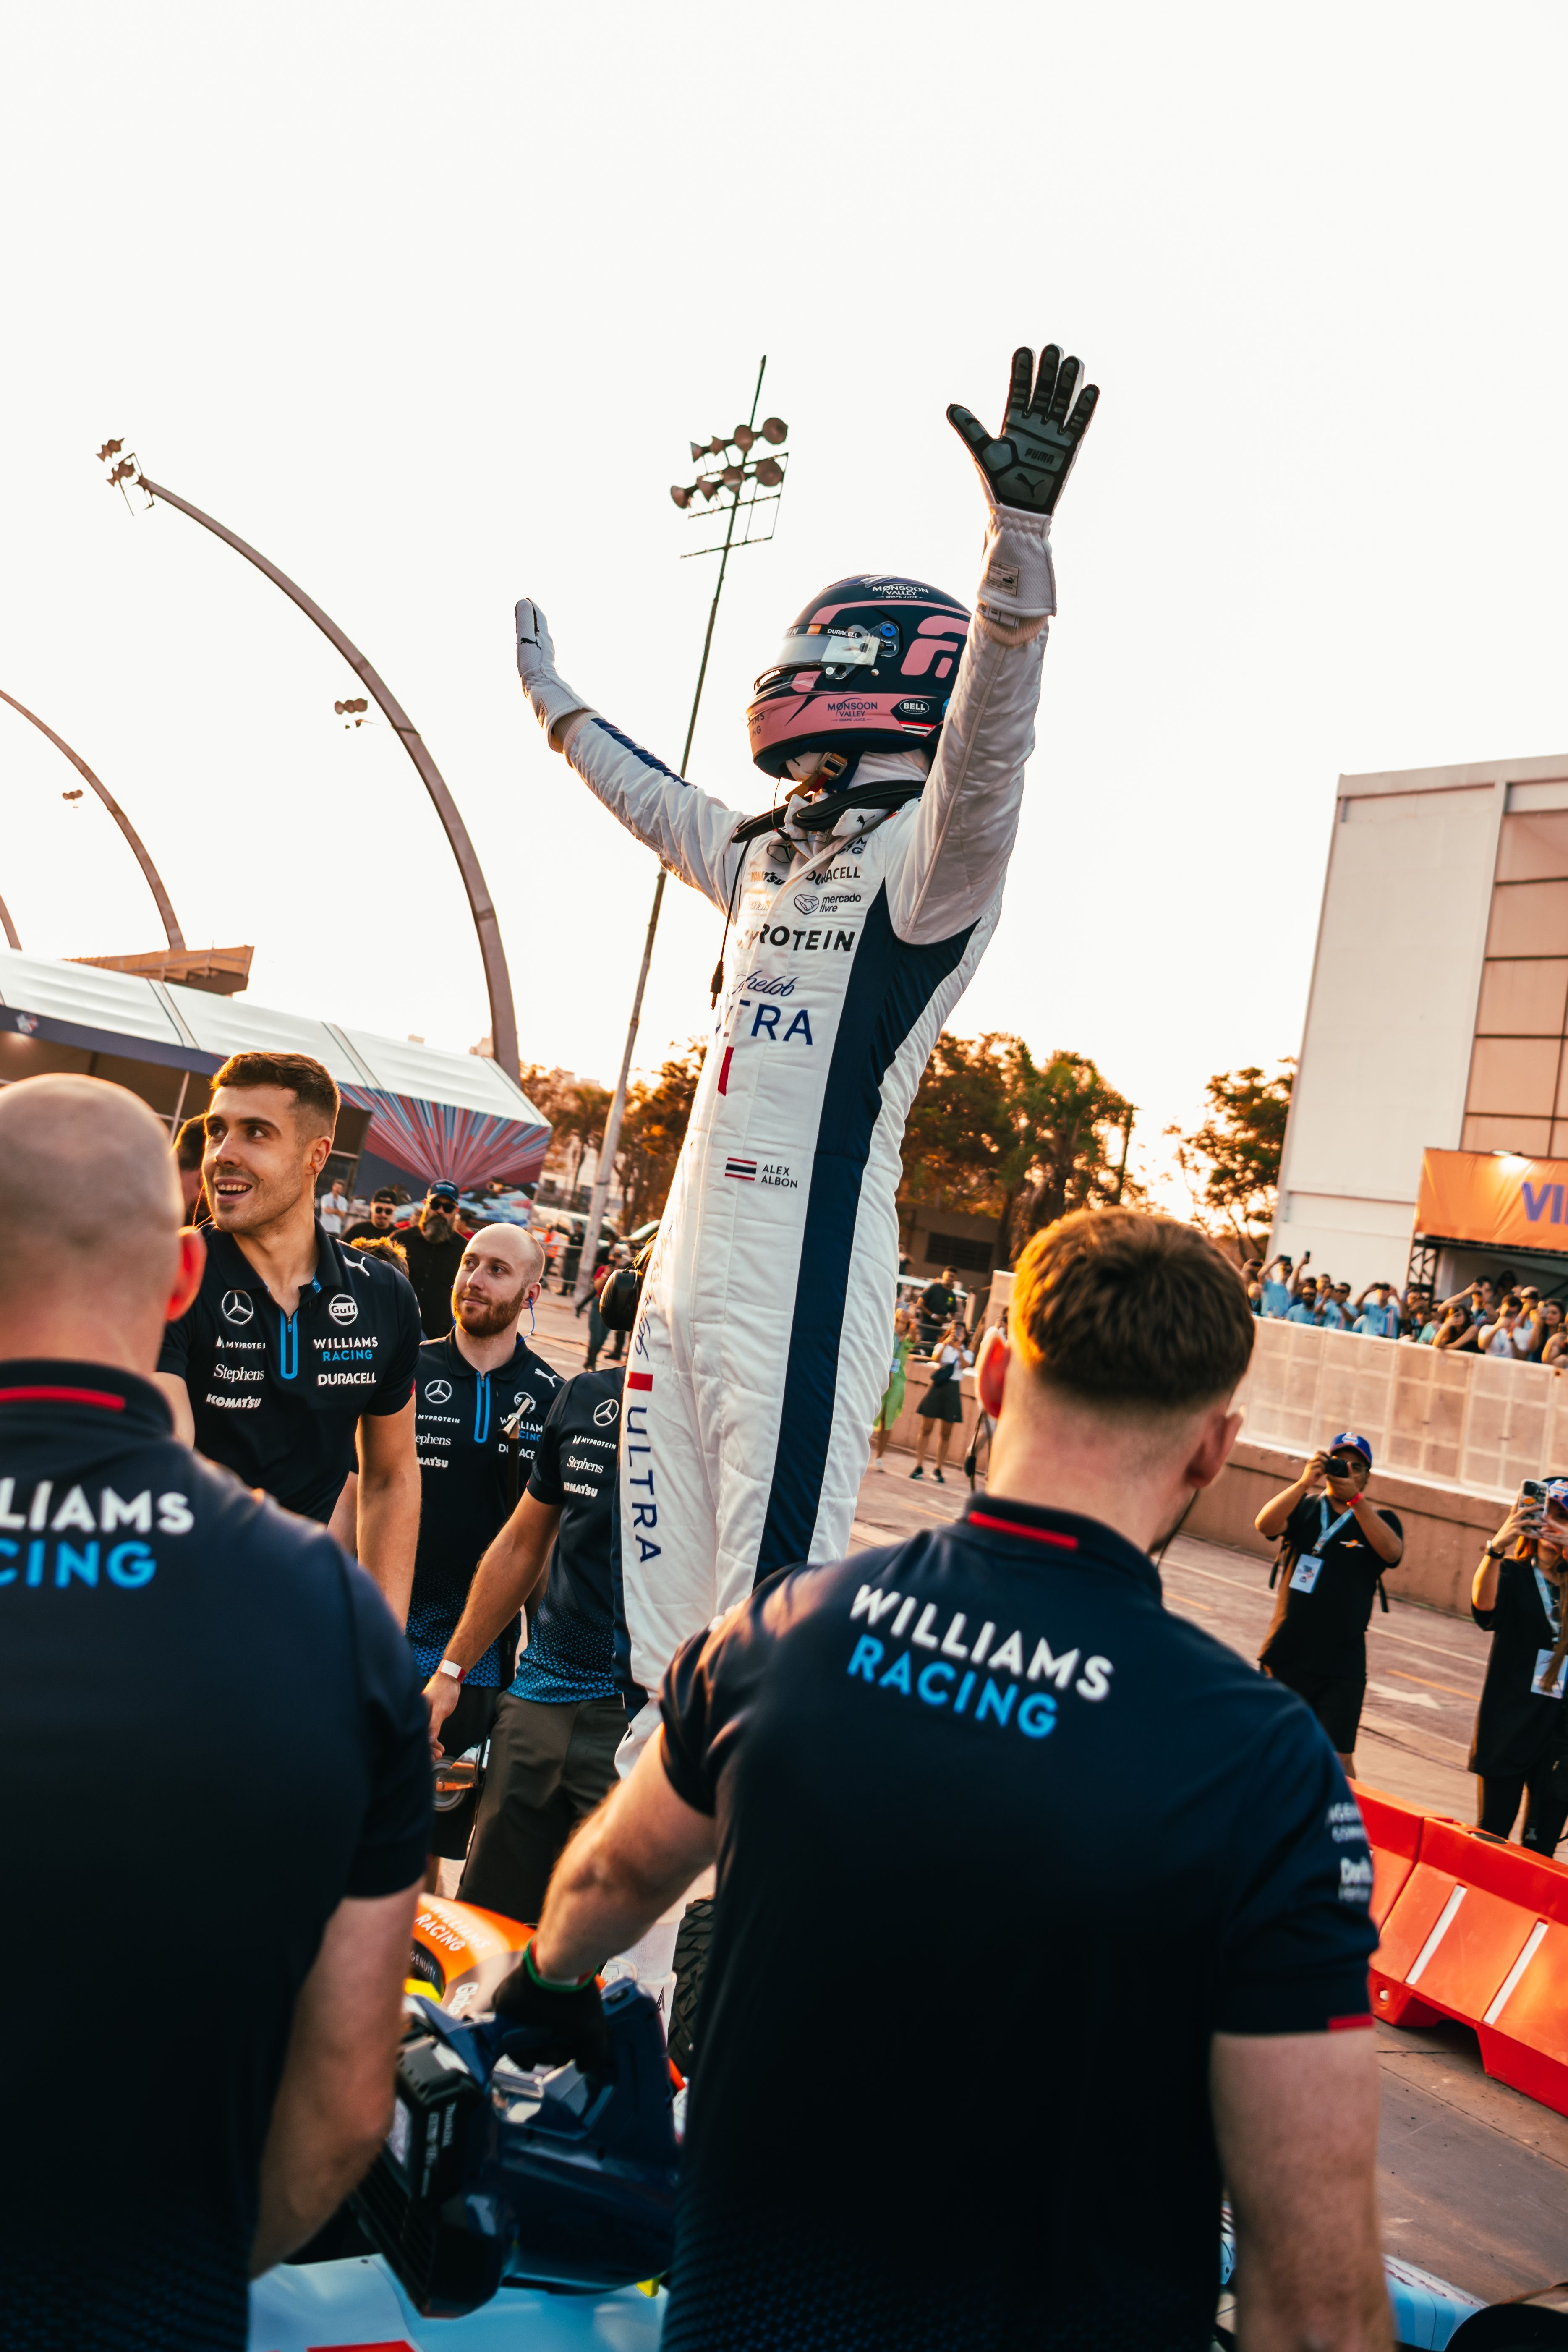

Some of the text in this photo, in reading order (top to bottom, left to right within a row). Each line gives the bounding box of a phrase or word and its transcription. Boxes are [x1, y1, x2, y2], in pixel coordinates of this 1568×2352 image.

[1025, 448, 1055, 465] PUMA
[827, 629, 858, 638] DURACELL
[805, 866, 861, 886] DURACELL
[822, 892, 861, 904] mercado
[819, 904, 838, 912] livre
[762, 1163, 790, 1176] ALEX
[761, 1174, 798, 1189] ALBON
[1522, 1182, 1568, 1225] VI
[332, 1304, 356, 1314] Gulf
[313, 1336, 378, 1349] WILLIAMS
[323, 1349, 373, 1362] RACING
[214, 1364, 264, 1382] Stephens
[318, 1372, 377, 1386] DURACELL
[206, 1393, 262, 1409] KOMATSU
[418, 1414, 460, 1423] MYPROTEIN
[581, 1437, 617, 1450] MYPROTEIN
[567, 1455, 604, 1474] Stephens
[627, 1406, 662, 1563] ULTRA
[849, 1584, 1115, 1702] WILLIAMS
[847, 1633, 1058, 1739] RACING
[415, 1913, 466, 1952] RACING
[429, 1904, 491, 1949] WILLIAMS
